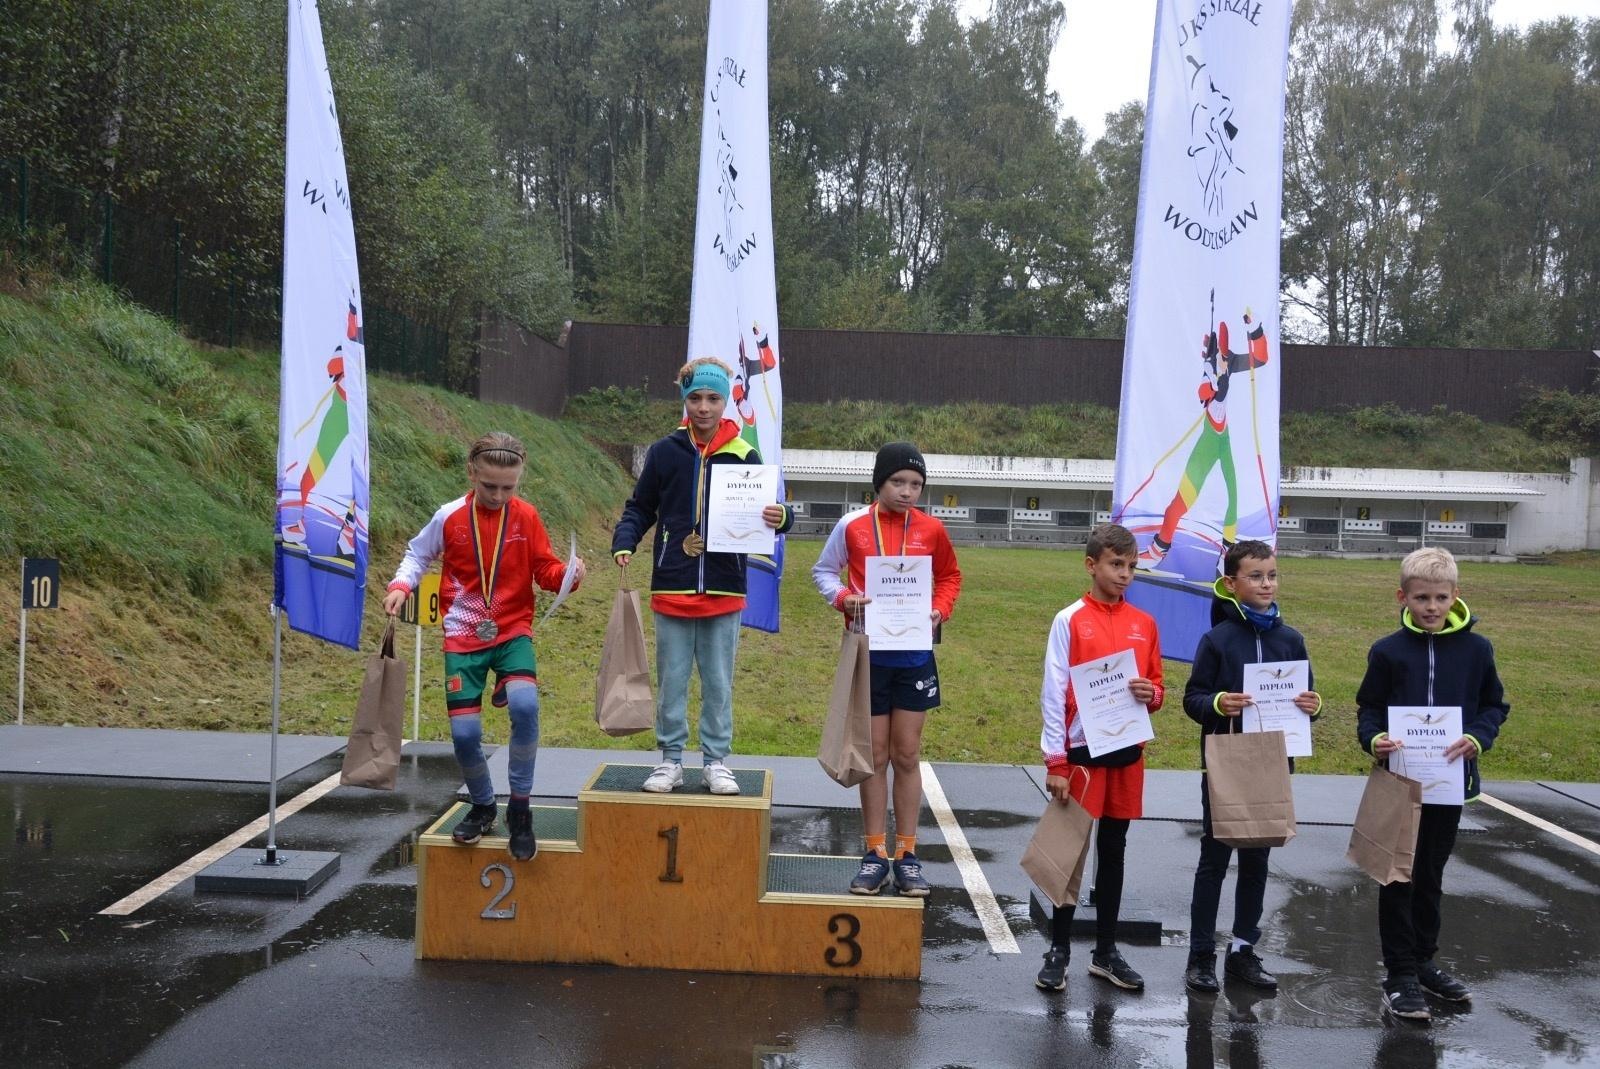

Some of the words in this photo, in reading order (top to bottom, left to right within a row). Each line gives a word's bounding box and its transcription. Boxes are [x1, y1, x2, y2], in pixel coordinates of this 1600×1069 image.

[31, 576, 51, 607] 10
[405, 591, 415, 622] 10
[429, 593, 438, 623] 9
[1089, 672, 1124, 689] DYPLOM
[1259, 682, 1294, 691] DYPLOM
[1407, 728, 1446, 736] DYPLOM
[657, 825, 684, 883] 1
[480, 863, 517, 920] 2
[824, 913, 864, 968] 3
